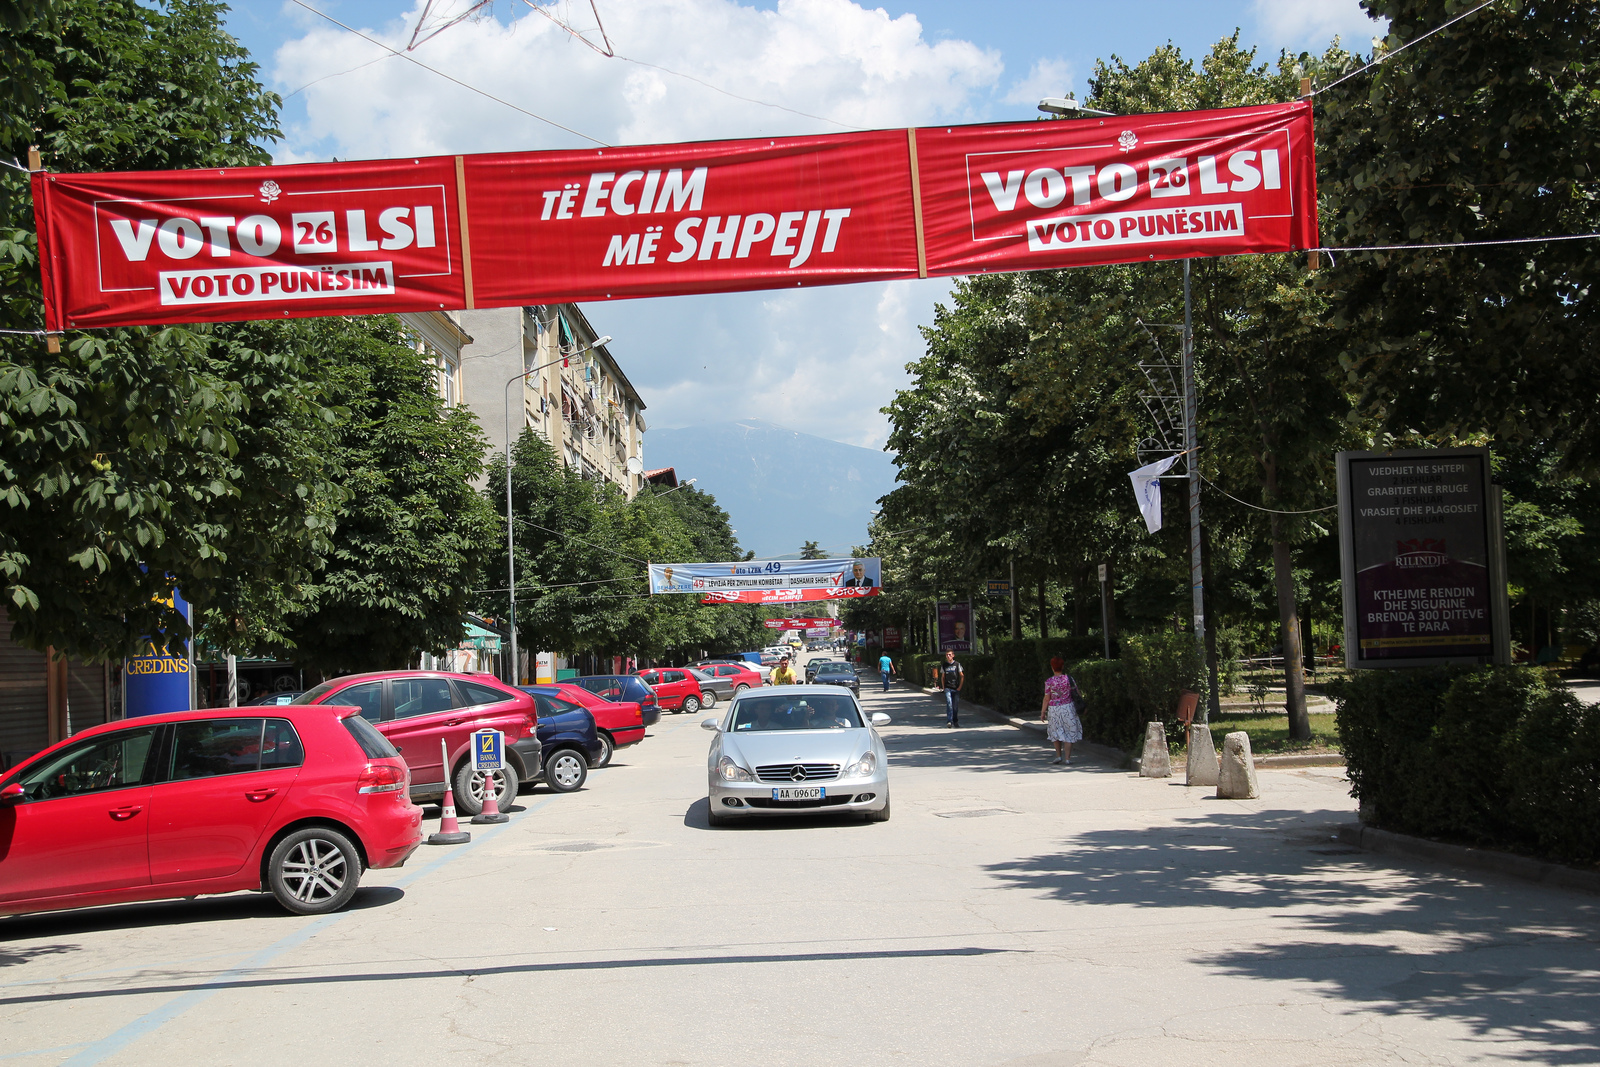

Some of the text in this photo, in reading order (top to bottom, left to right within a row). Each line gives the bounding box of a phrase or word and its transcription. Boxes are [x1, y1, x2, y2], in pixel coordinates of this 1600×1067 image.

[980, 148, 1282, 212] VOTO 26 LSI
[540, 166, 708, 220] TË ECIM
[1034, 208, 1238, 245] VOTO PUNËSIM
[110, 205, 436, 261] VOTO 26 LSI
[602, 208, 852, 268] MË SHPEJT
[166, 266, 388, 298] VOTO PUNËSIM
[1368, 464, 1465, 476] VJEDHJET NE SHTEPI
[1393, 476, 1442, 485] 2 FISHUAR
[1368, 484, 1468, 496] GRABITJET NE RRUGE
[1394, 496, 1443, 505] 3 FISHUAR
[1360, 504, 1478, 516] VRASJET DHE PLAGOSJET
[1404, 516, 1444, 525] FISHUAR
[765, 562, 781, 573] 49
[1394, 556, 1449, 567] RILINDJE
[693, 580, 704, 588] 49
[1374, 587, 1475, 600] KTHEJME RENDIN
[1384, 598, 1465, 611] DHE SIGURINE
[1368, 609, 1484, 622] BRENDA 300 DITEVE
[1402, 621, 1450, 632] TE PARA
[126, 658, 189, 675] CREDINS
[780, 789, 820, 798] AA 096 CP
